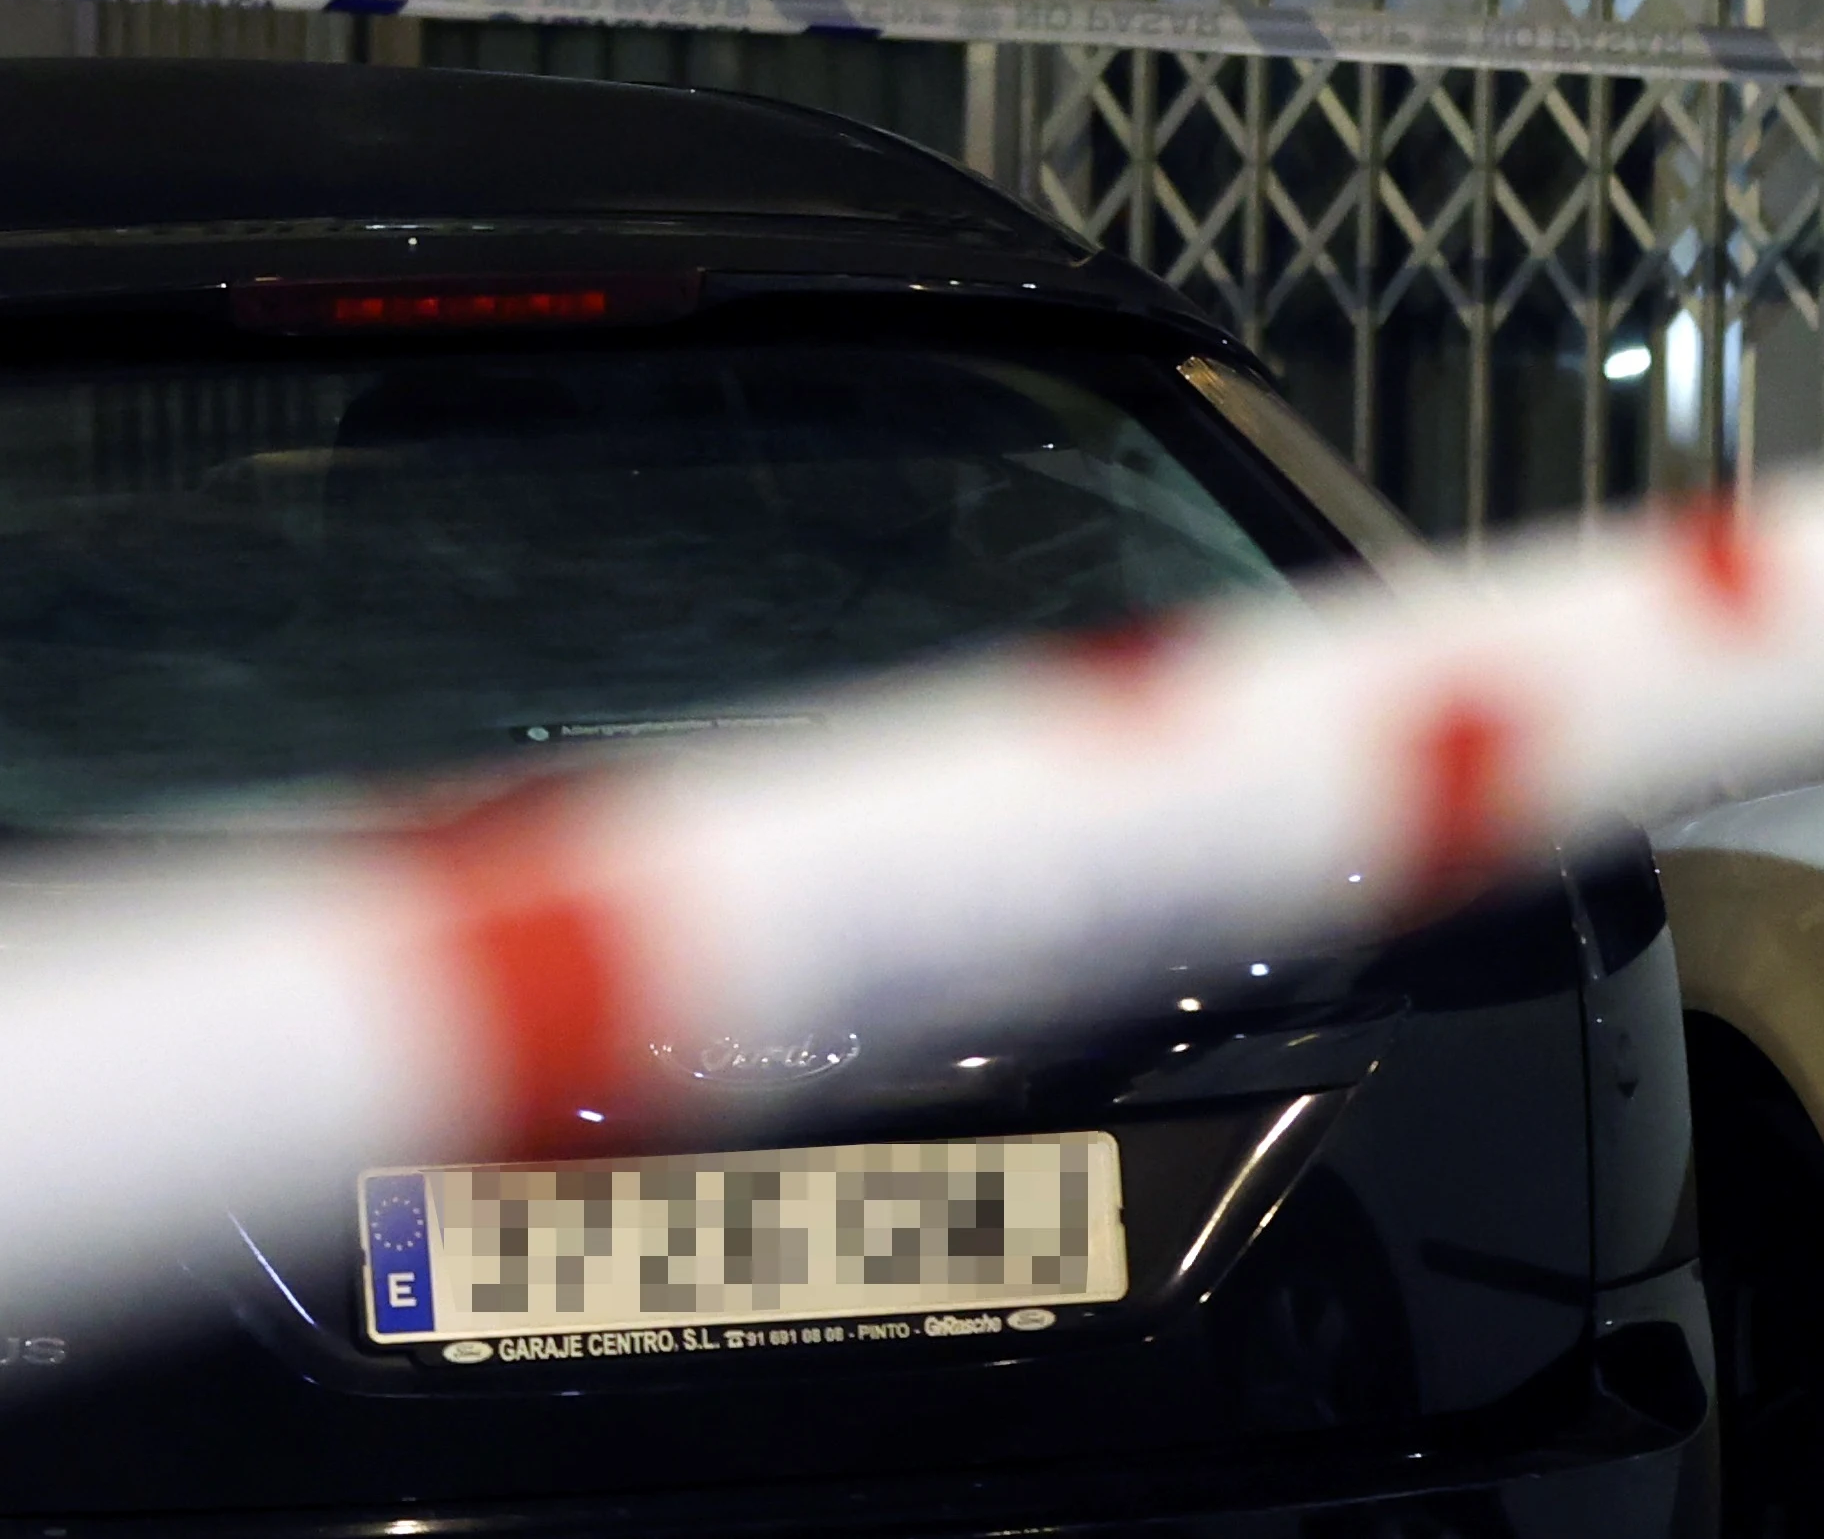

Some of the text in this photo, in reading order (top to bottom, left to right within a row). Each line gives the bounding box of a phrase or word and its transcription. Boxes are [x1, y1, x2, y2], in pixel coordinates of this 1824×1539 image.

[387, 1272, 417, 1309] E
[498, 1334, 585, 1362] GARAJE
[682, 1328, 721, 1352] S.L.
[857, 1321, 911, 1342] PINTO
